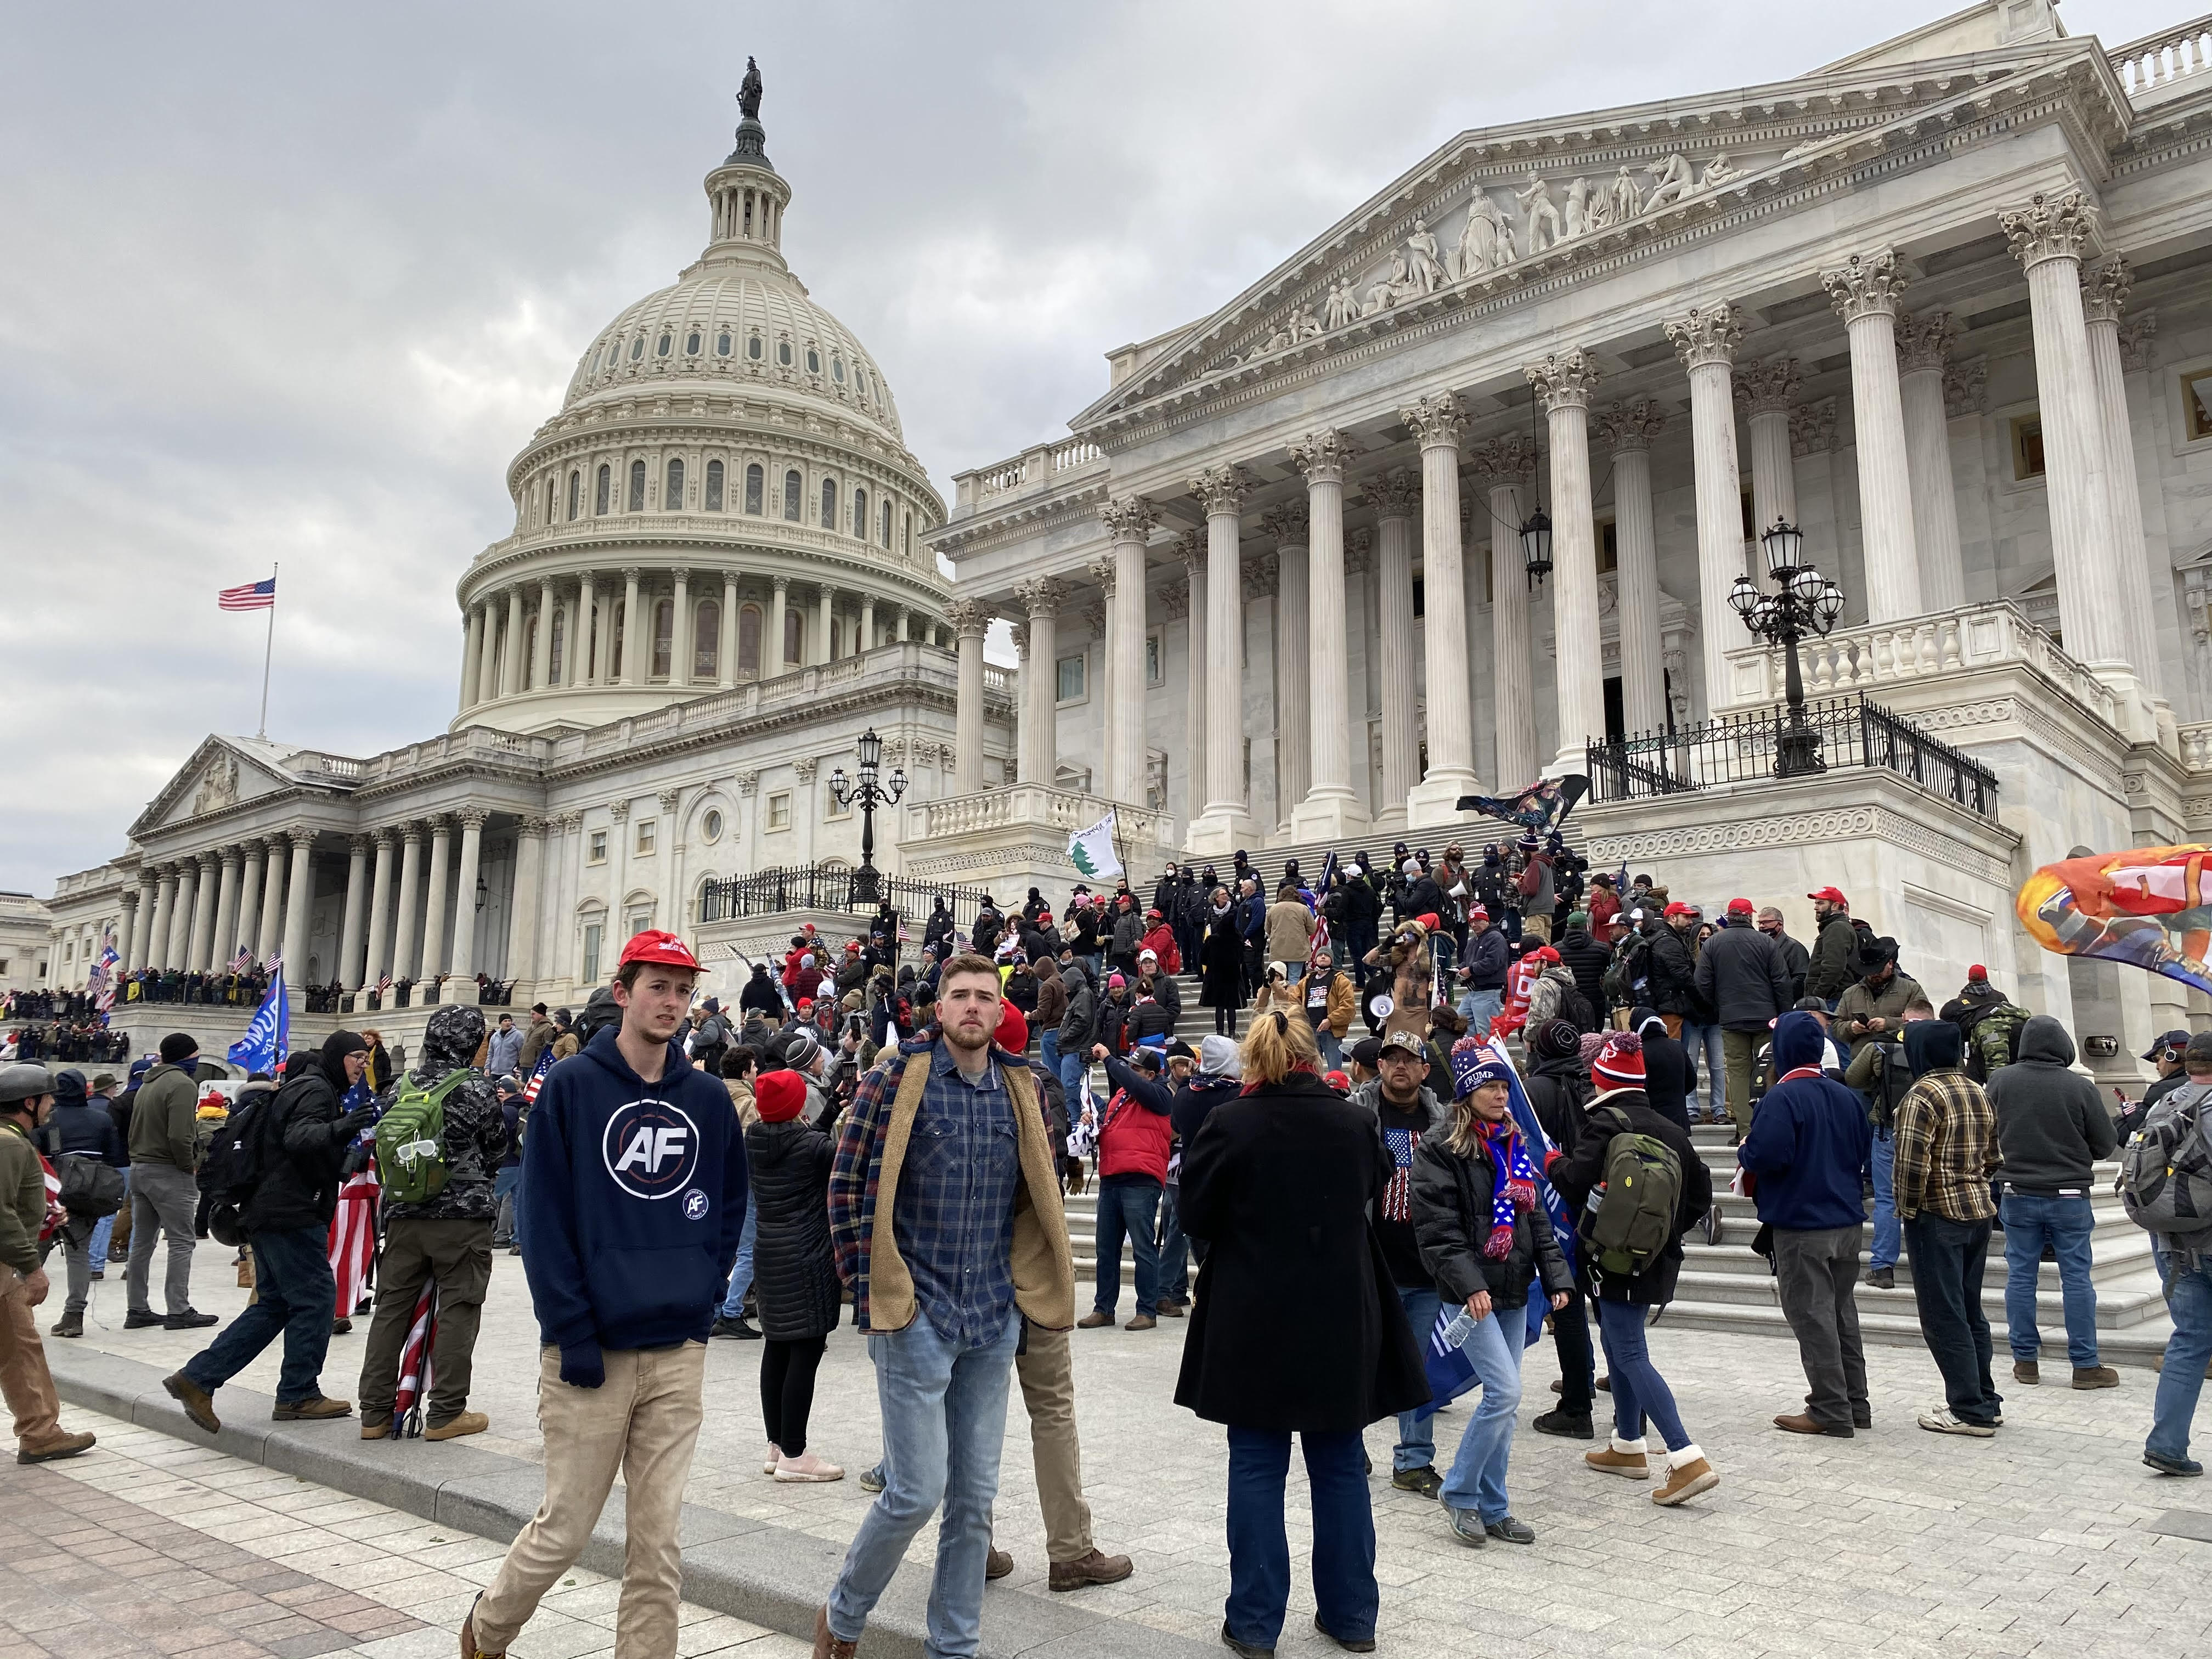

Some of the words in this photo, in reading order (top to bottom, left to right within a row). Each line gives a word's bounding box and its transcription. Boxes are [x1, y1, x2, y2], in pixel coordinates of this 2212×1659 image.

[1464, 1071, 1494, 1088] TRUMP
[614, 1127, 687, 1173] AF
[686, 1190, 699, 1198] AMERICA
[687, 1195, 703, 1214] AF
